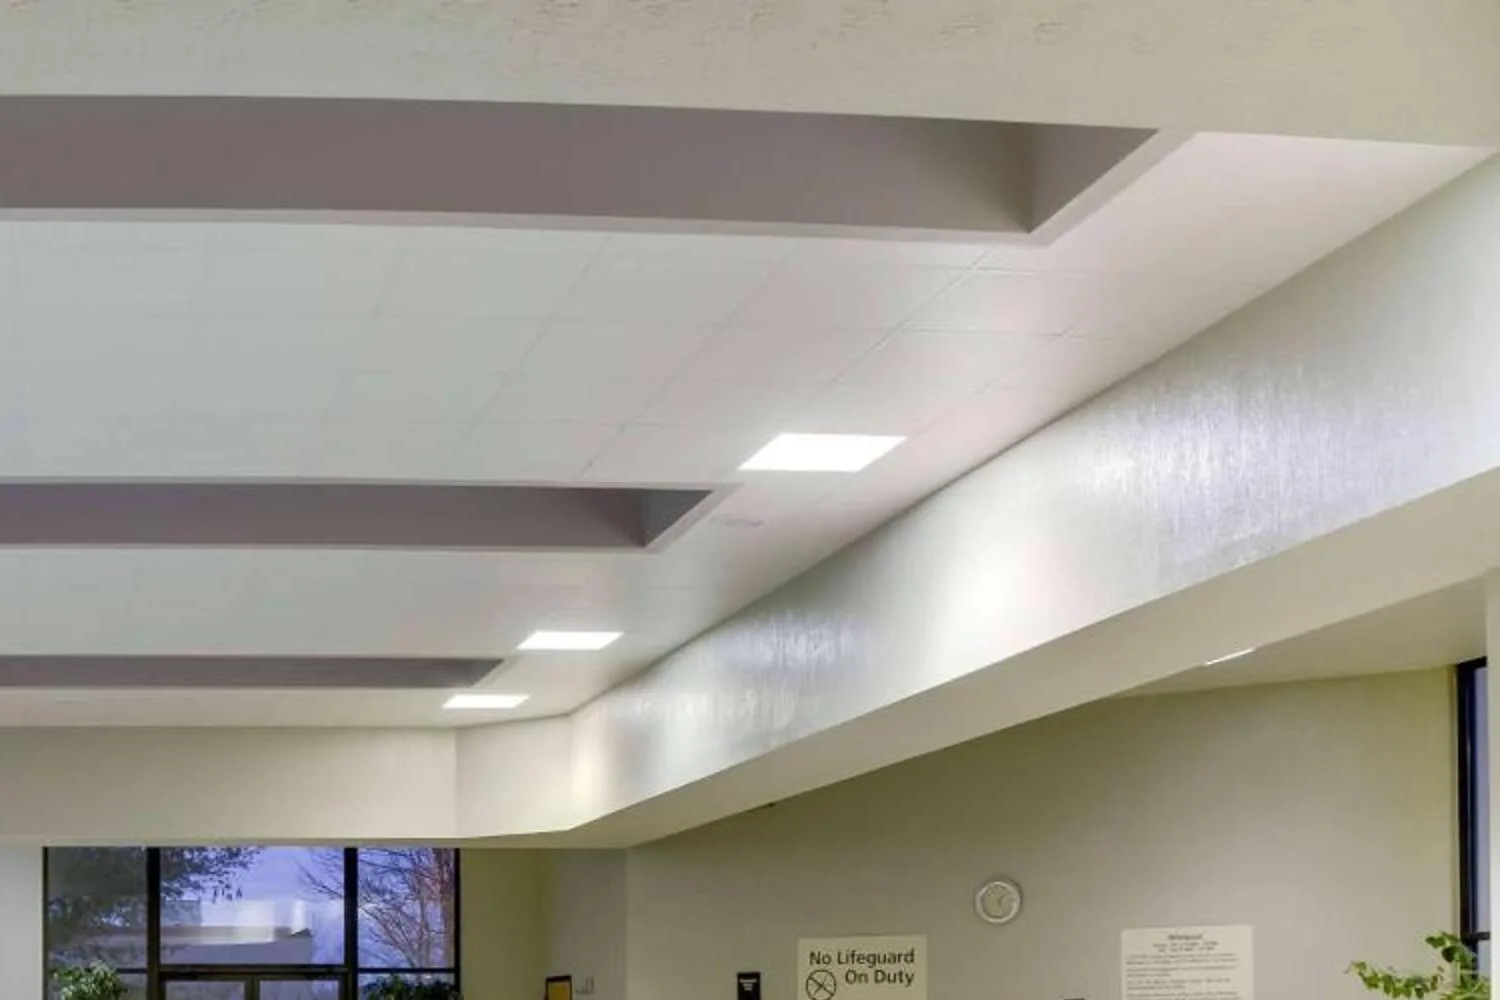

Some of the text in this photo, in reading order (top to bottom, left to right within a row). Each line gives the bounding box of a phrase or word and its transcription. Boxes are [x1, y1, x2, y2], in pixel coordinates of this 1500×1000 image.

[809, 947, 915, 968] No Lifeguard
[845, 969, 915, 988] On Duty
